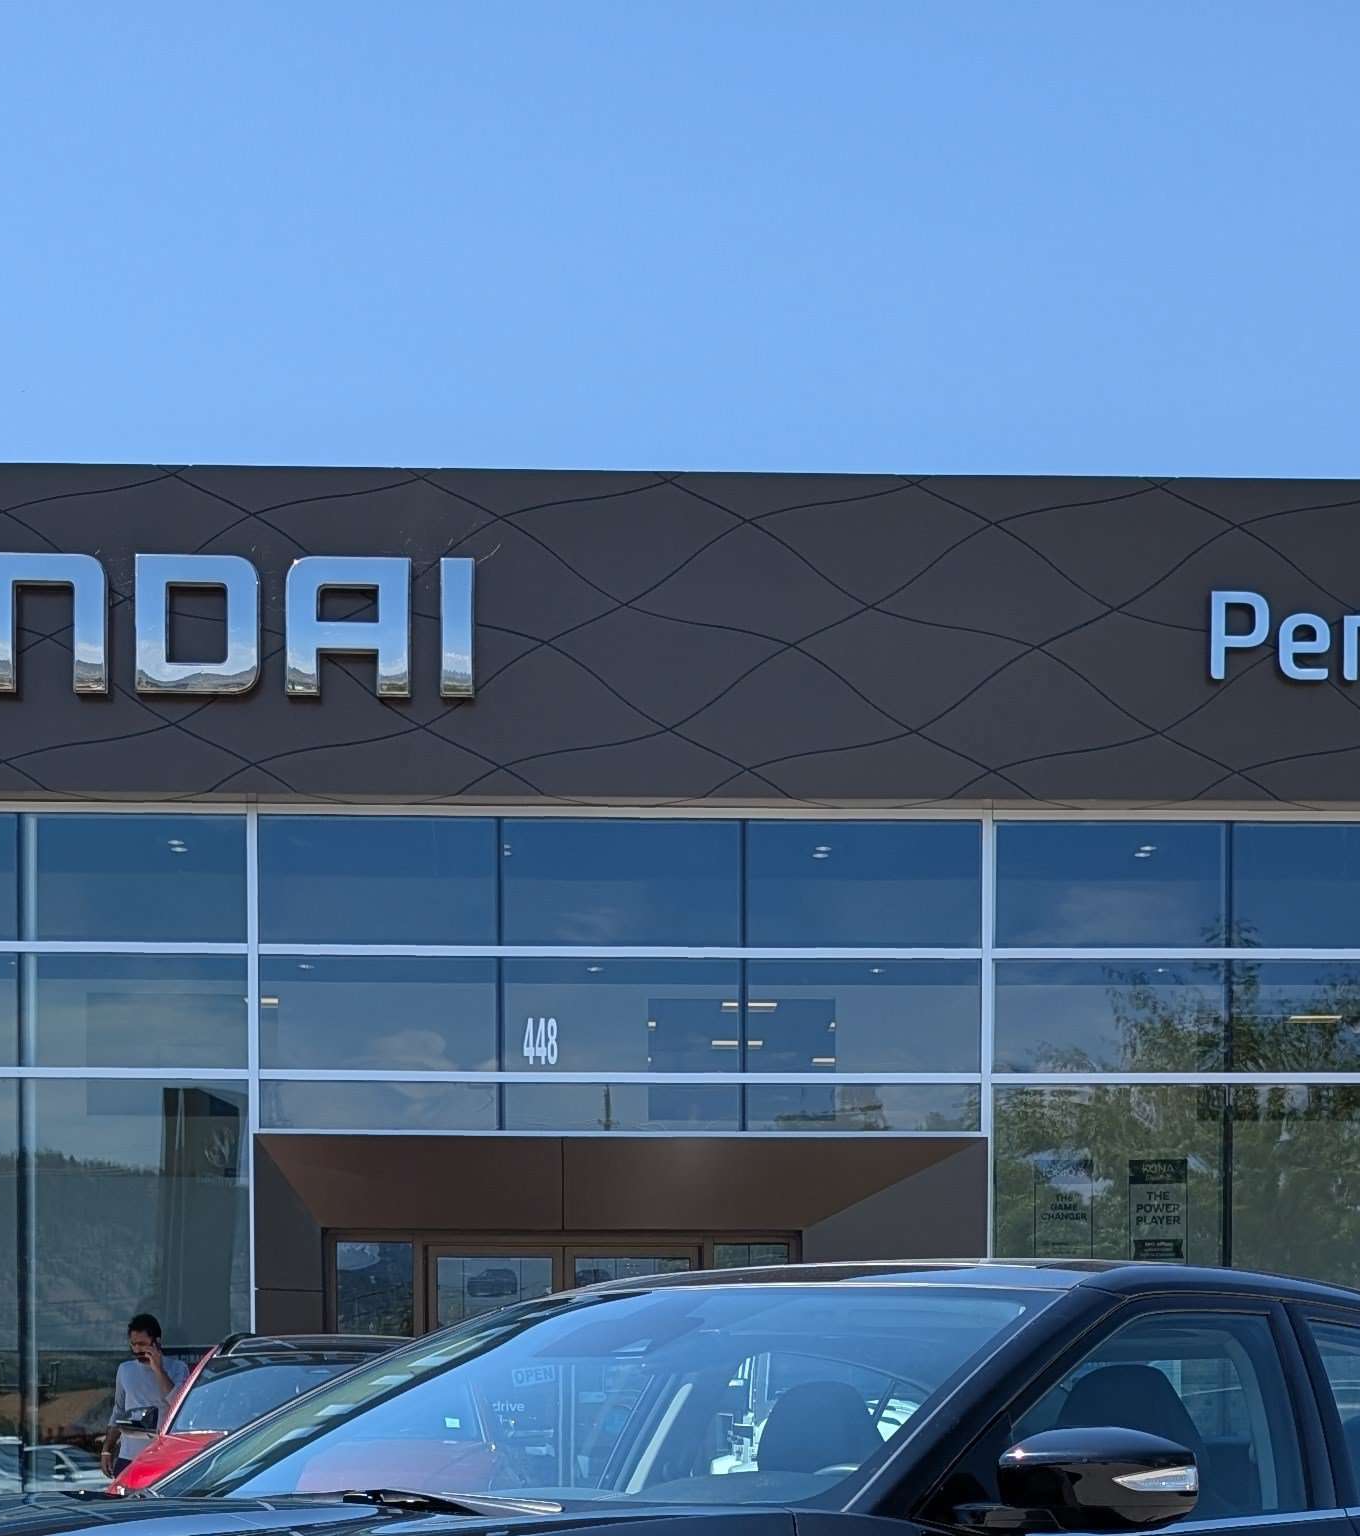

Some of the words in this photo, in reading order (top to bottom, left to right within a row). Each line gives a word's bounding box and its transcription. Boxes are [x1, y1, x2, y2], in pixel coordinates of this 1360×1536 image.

[523, 1017, 558, 1065] 448
[1146, 1191, 1170, 1200] THE
[1136, 1203, 1181, 1214] POWER
[1041, 1212, 1088, 1222] CHANGER
[1136, 1215, 1181, 1226] PLAYER
[513, 1367, 554, 1385] OPEN
